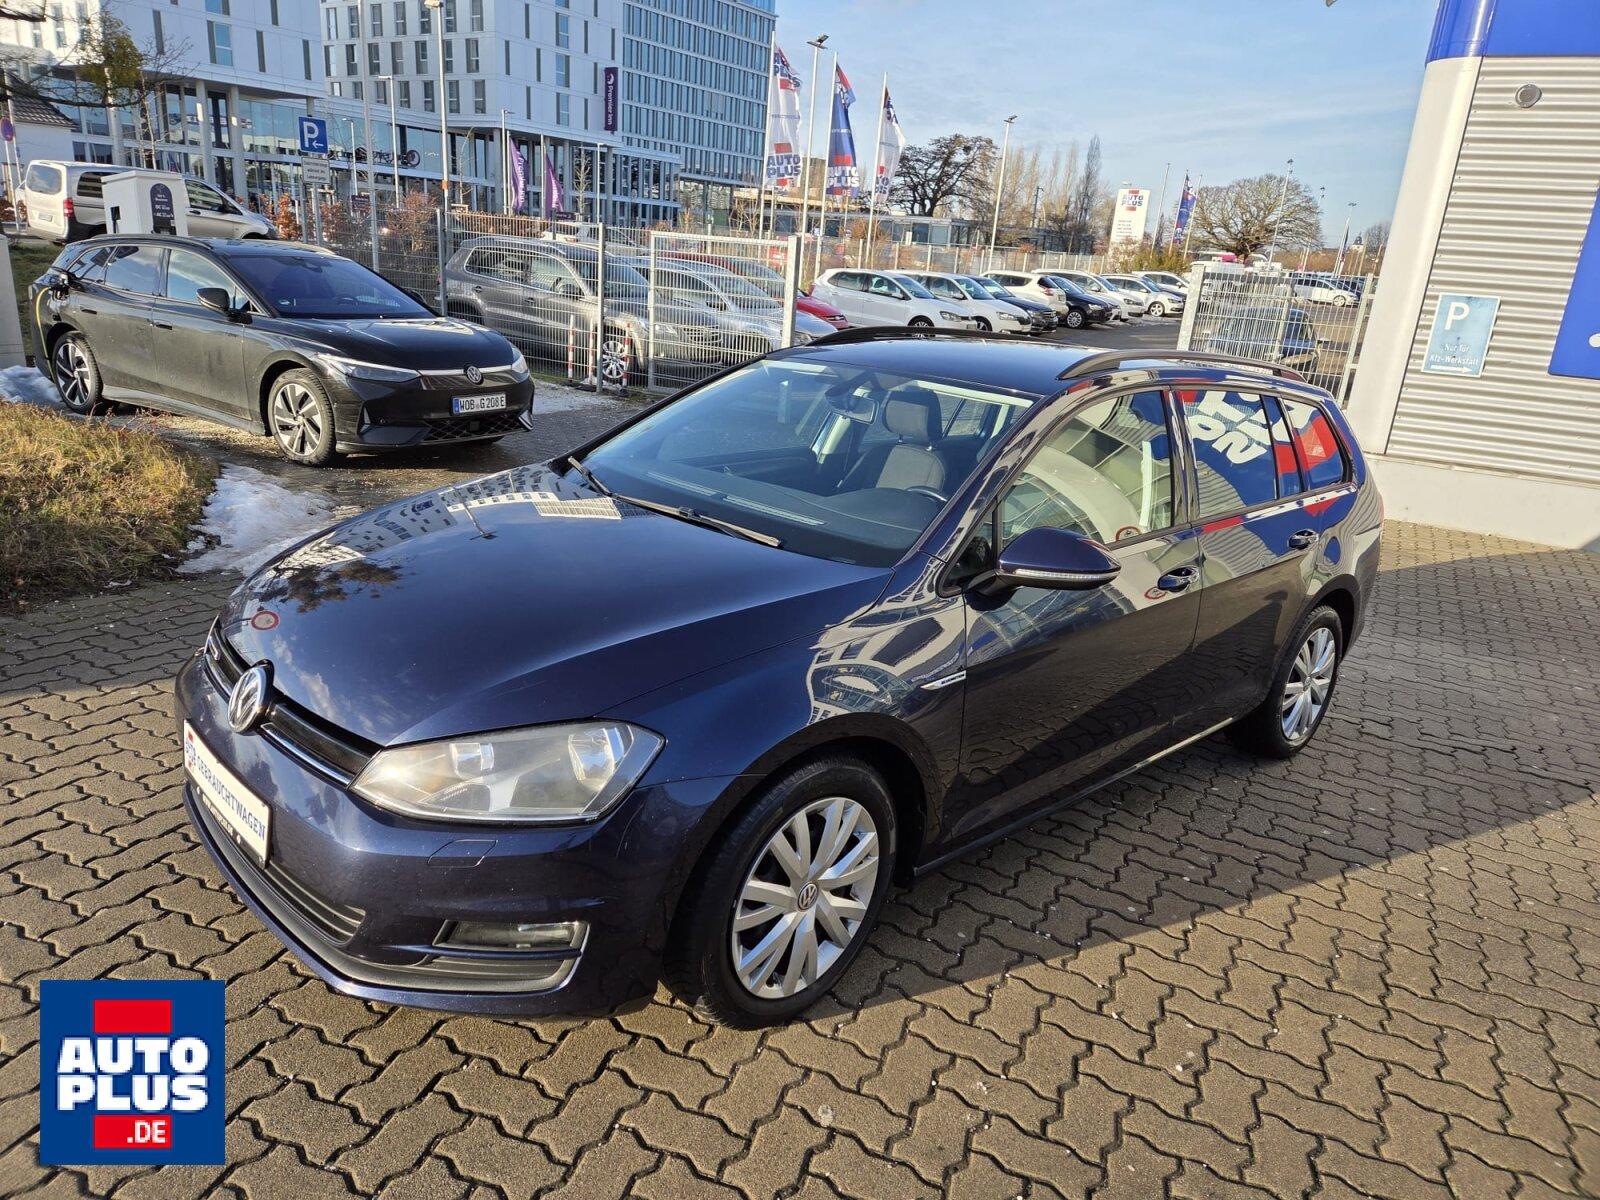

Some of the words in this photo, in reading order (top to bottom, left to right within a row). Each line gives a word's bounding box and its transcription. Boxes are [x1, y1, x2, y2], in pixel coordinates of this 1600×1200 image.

[303, 121, 319, 148] P
[767, 154, 801, 166] AUTO
[767, 165, 802, 178] PLUS
[828, 166, 859, 177] AUTO
[827, 177, 860, 188] PLUS
[1444, 301, 1470, 330] P
[1444, 344, 1458, 352] Nur
[1459, 344, 1470, 353] für
[1429, 354, 1479, 366] Kfz-Werkstatt
